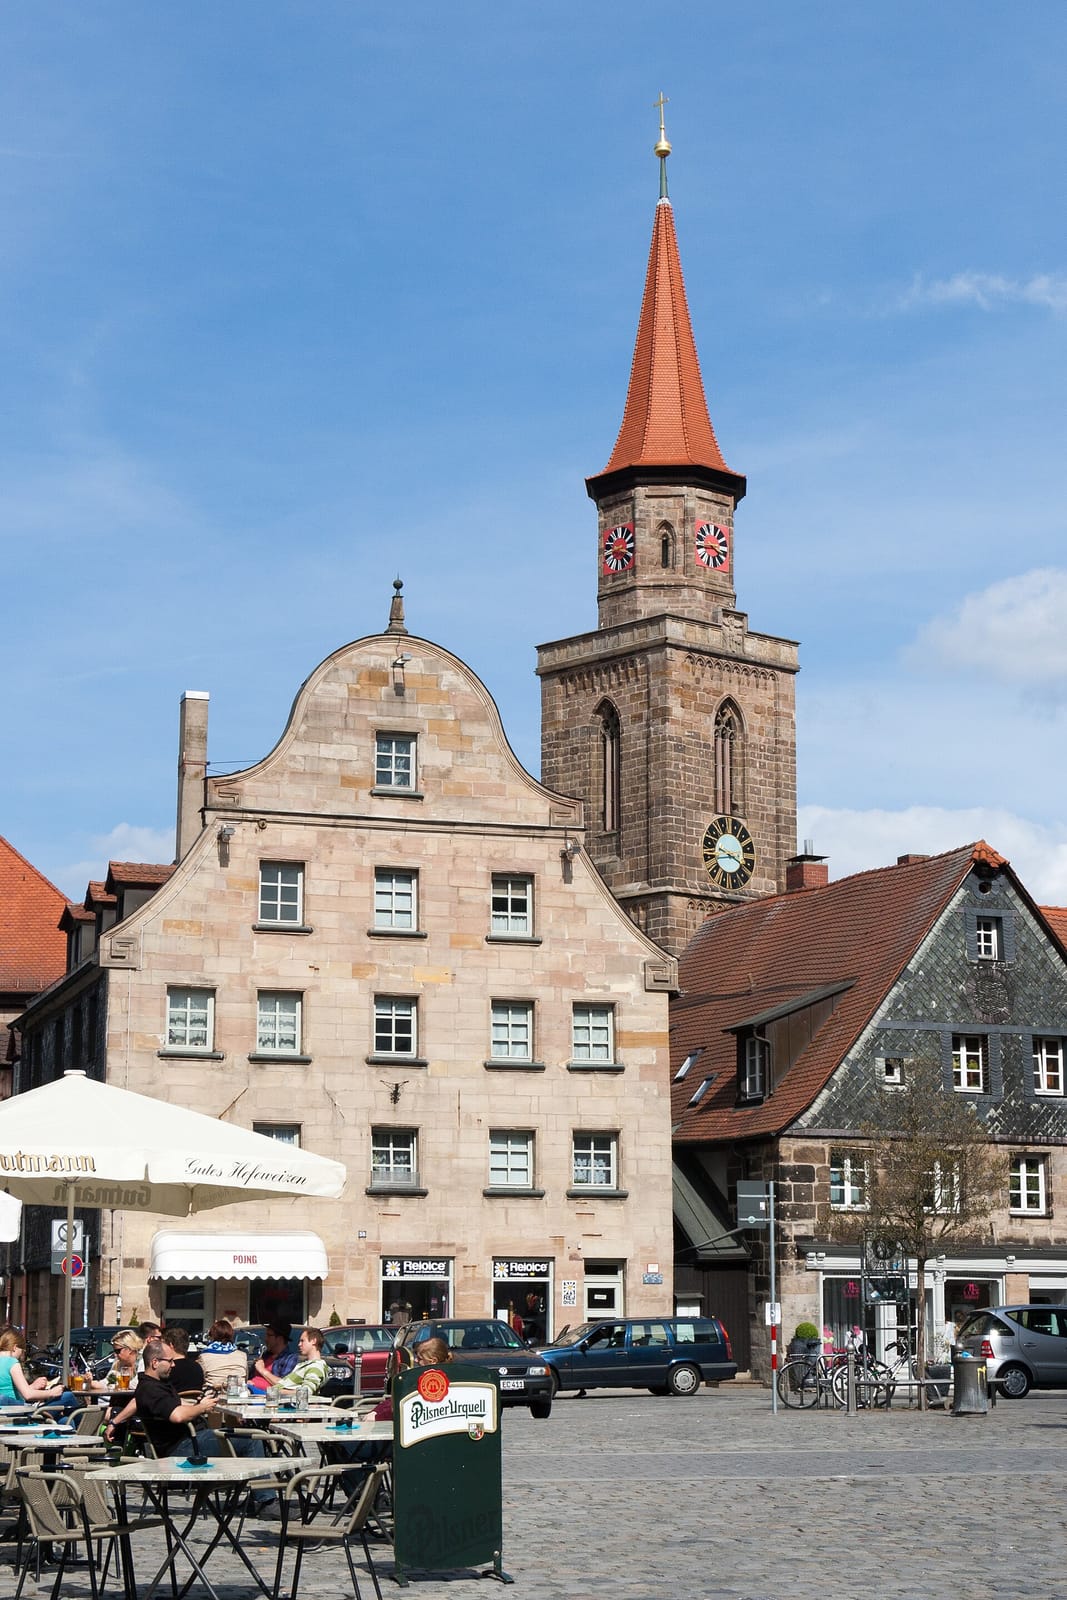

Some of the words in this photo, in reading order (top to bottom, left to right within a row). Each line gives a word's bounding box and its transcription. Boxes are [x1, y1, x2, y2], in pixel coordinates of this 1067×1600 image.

[0, 1150, 97, 1173] utmann
[184, 1157, 223, 1178] Gutes
[227, 1159, 308, 1186] Hefeweizen
[410, 1401, 450, 1429] Pilsner
[448, 1399, 486, 1419] Urquell
